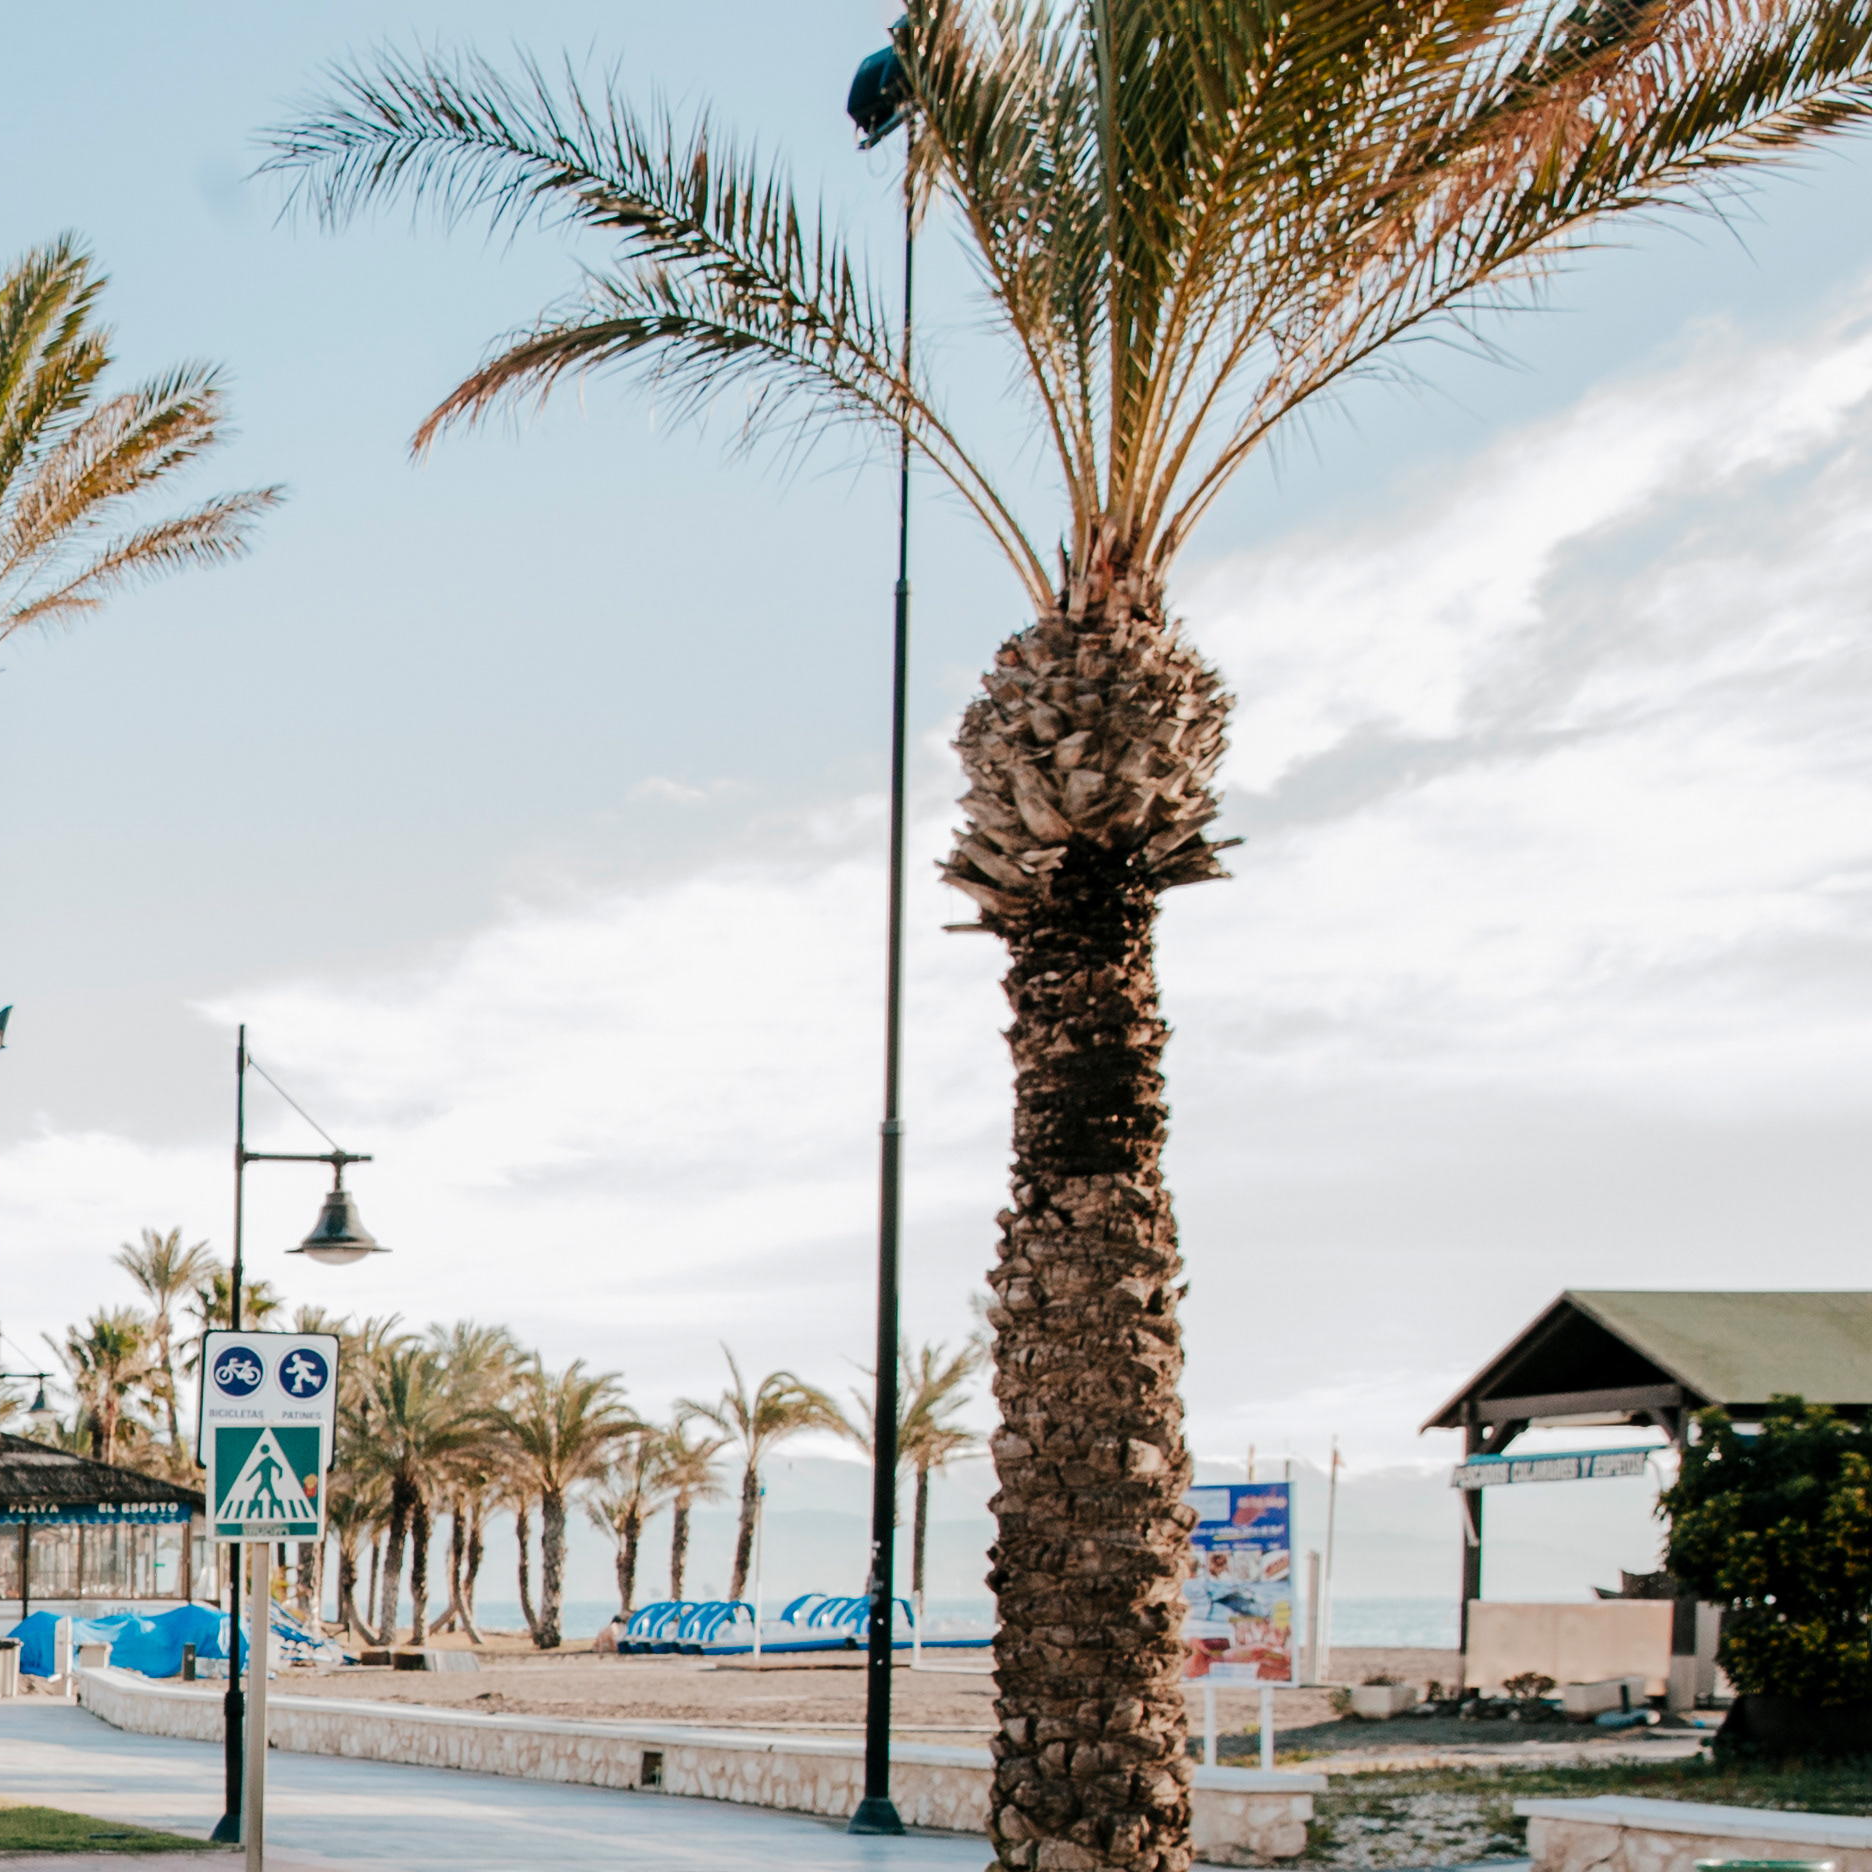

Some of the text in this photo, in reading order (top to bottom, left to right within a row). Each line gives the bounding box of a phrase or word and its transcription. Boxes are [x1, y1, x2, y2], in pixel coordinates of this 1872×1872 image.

[209, 1408, 322, 1420] BICICLETAS PATINES
[8, 1503, 60, 1514] PLAYA
[97, 1501, 117, 1514] EL
[120, 1501, 180, 1515] ESPETO
